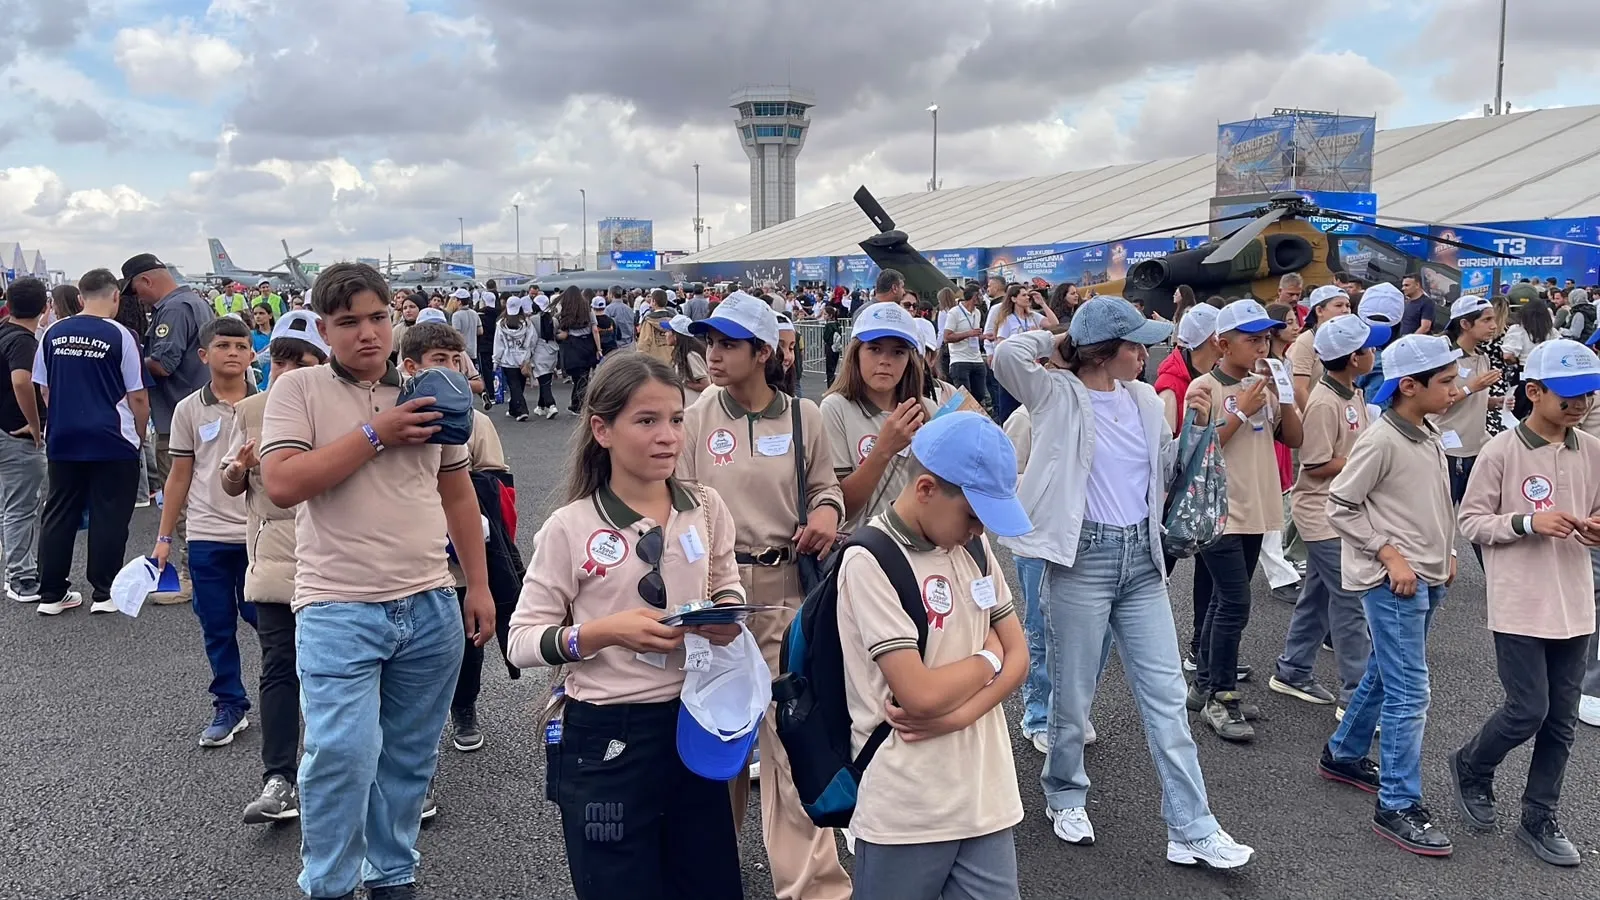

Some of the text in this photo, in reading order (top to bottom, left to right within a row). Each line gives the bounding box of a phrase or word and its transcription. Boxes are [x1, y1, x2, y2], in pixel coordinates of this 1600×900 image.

[1493, 237, 1526, 255] T3
[52, 336, 111, 351] RED BULL KTM
[53, 347, 106, 359] RACING TEAM
[585, 802, 624, 821] MIU
[585, 822, 624, 842] MIU
